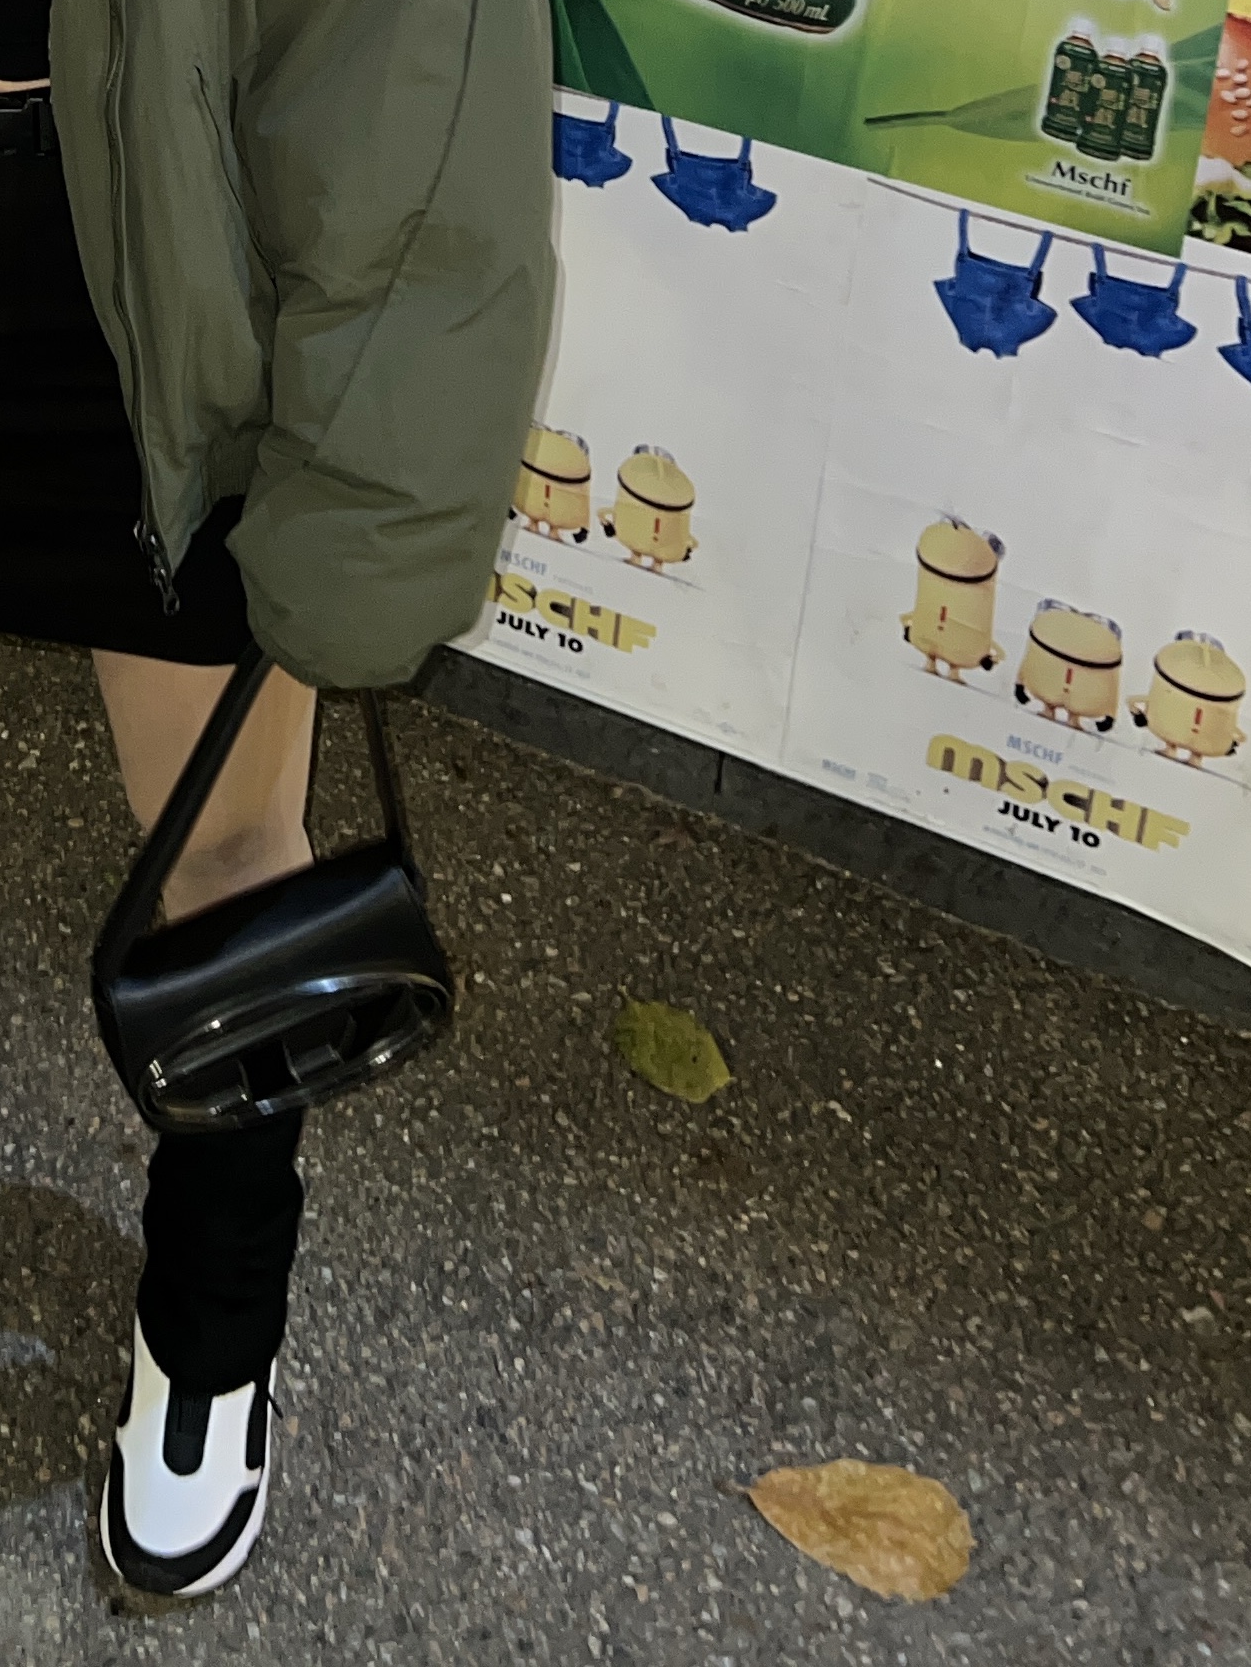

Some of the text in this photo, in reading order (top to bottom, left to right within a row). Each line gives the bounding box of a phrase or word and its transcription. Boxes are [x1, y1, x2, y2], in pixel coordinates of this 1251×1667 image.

[1052, 160, 1132, 196] Mschf
[489, 569, 657, 655] SCHF
[497, 611, 584, 653] JULY 10
[998, 800, 1101, 849] JULY 10
